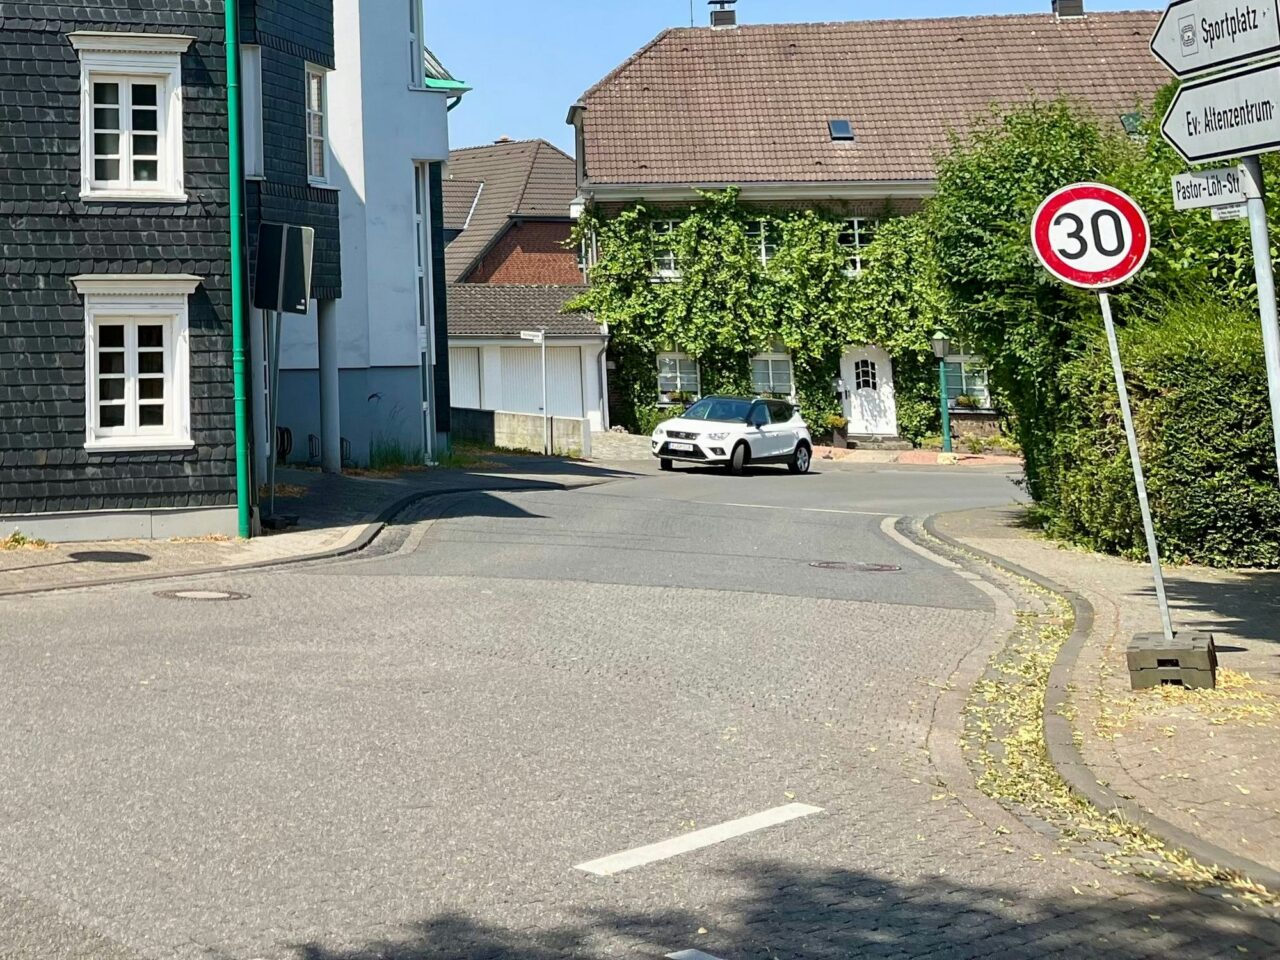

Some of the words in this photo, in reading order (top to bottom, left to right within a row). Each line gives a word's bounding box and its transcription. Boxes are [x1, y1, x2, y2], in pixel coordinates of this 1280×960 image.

[1201, 5, 1259, 49] Sportplatz
[1204, 99, 1273, 133] Altenzentrum
[1053, 209, 1125, 260] 30
